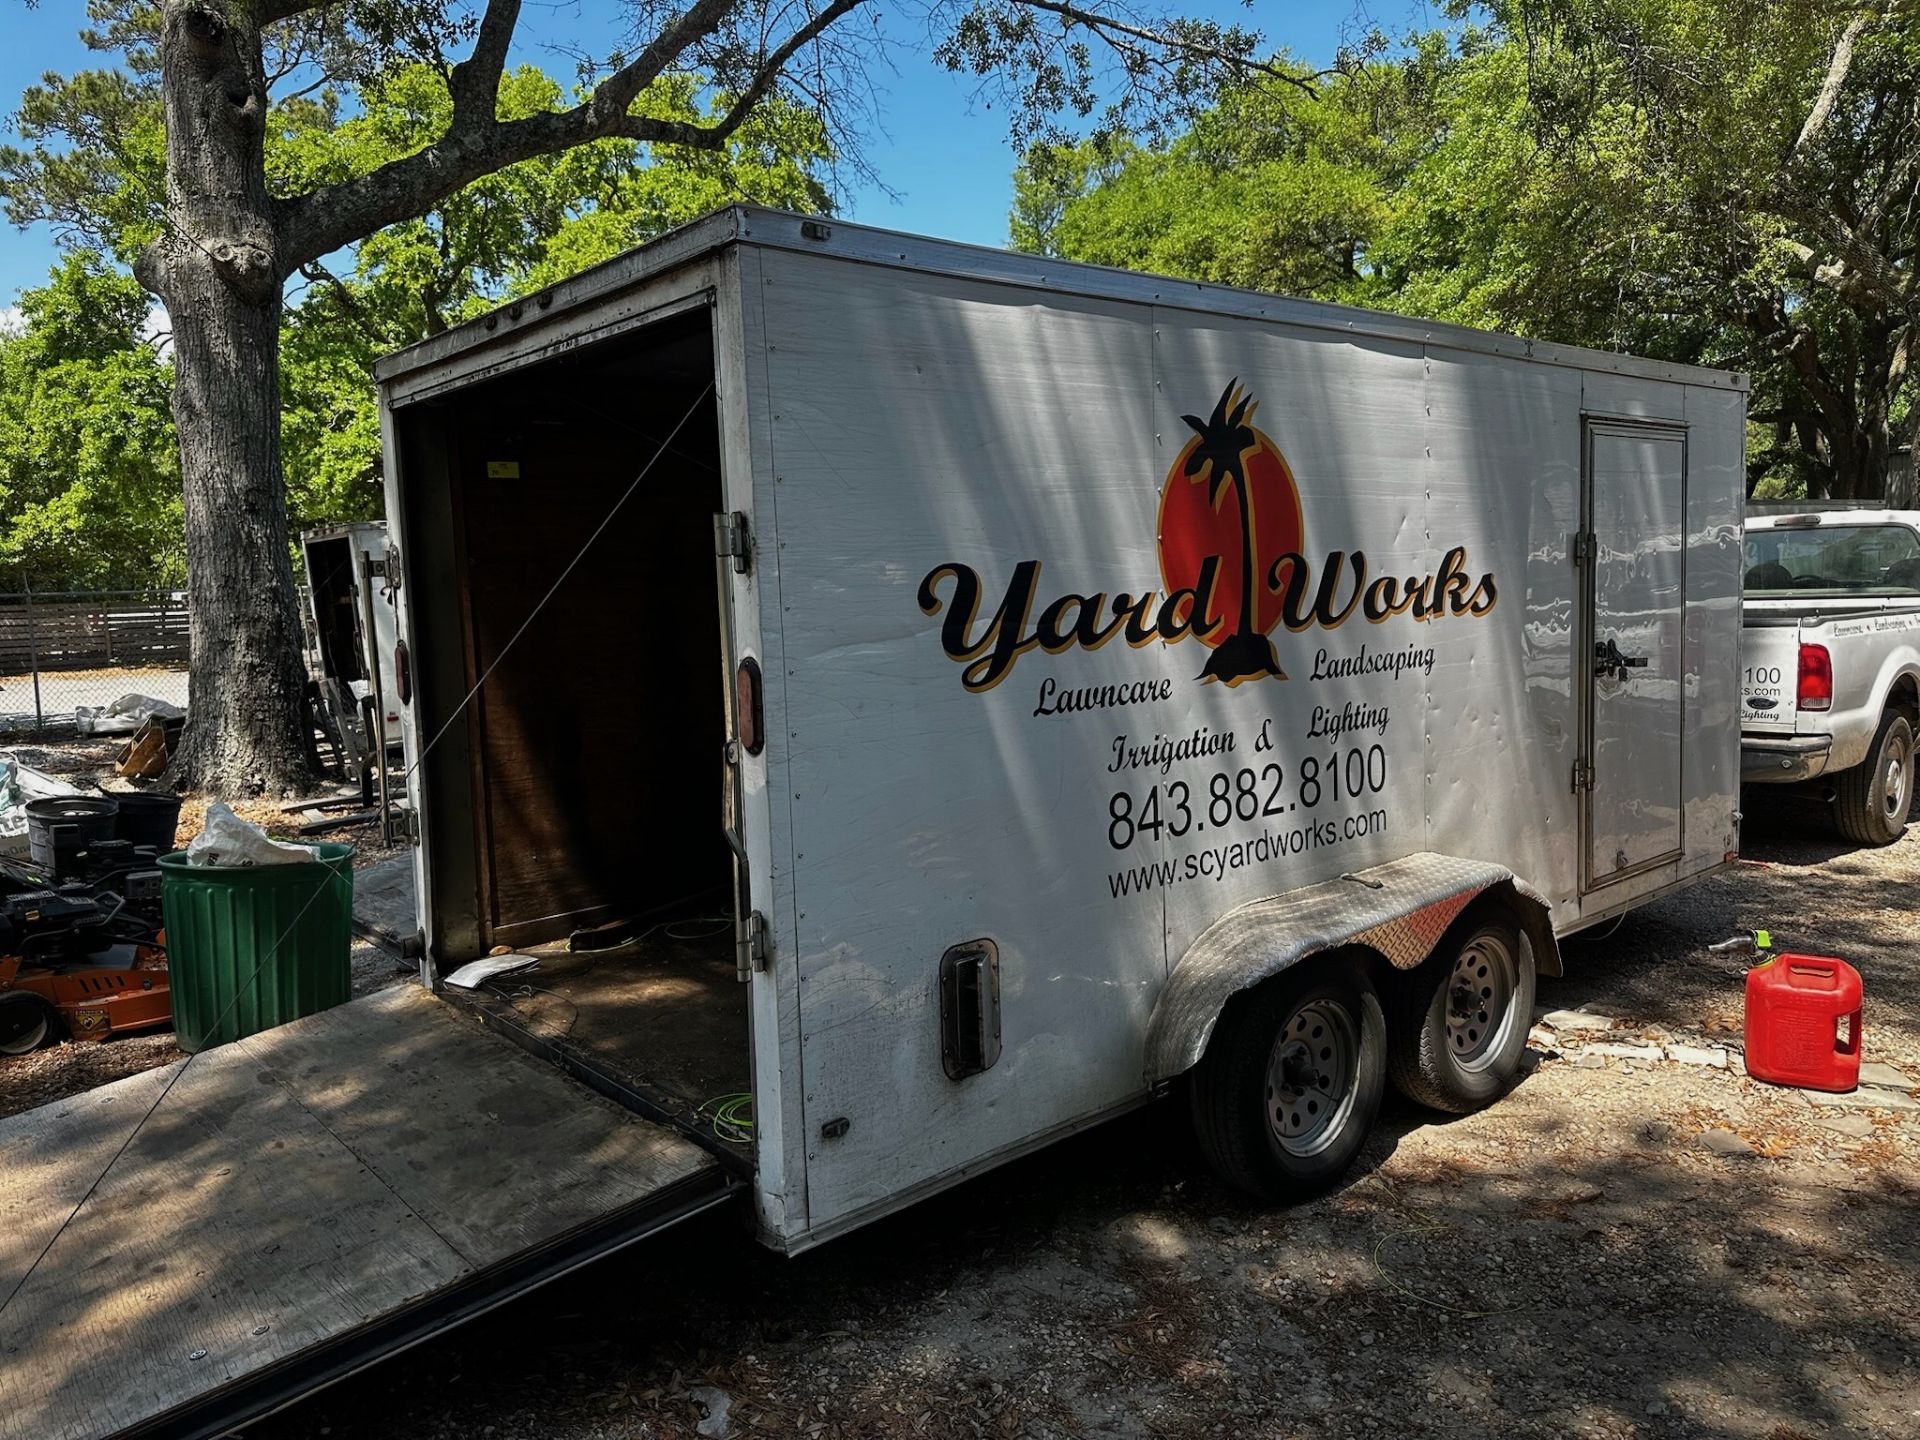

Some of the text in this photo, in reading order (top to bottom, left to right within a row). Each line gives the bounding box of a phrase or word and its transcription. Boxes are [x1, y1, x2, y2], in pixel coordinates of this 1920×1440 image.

[917, 546, 1498, 693] Yard Works
[1033, 643, 1436, 717] Lawncare Landscaping
[1107, 726, 1237, 775] Irrigation
[1306, 701, 1391, 744] Lighting
[1107, 743, 1387, 851] 843.882.8100
[1107, 808, 1388, 899] www.scyardworks.com
